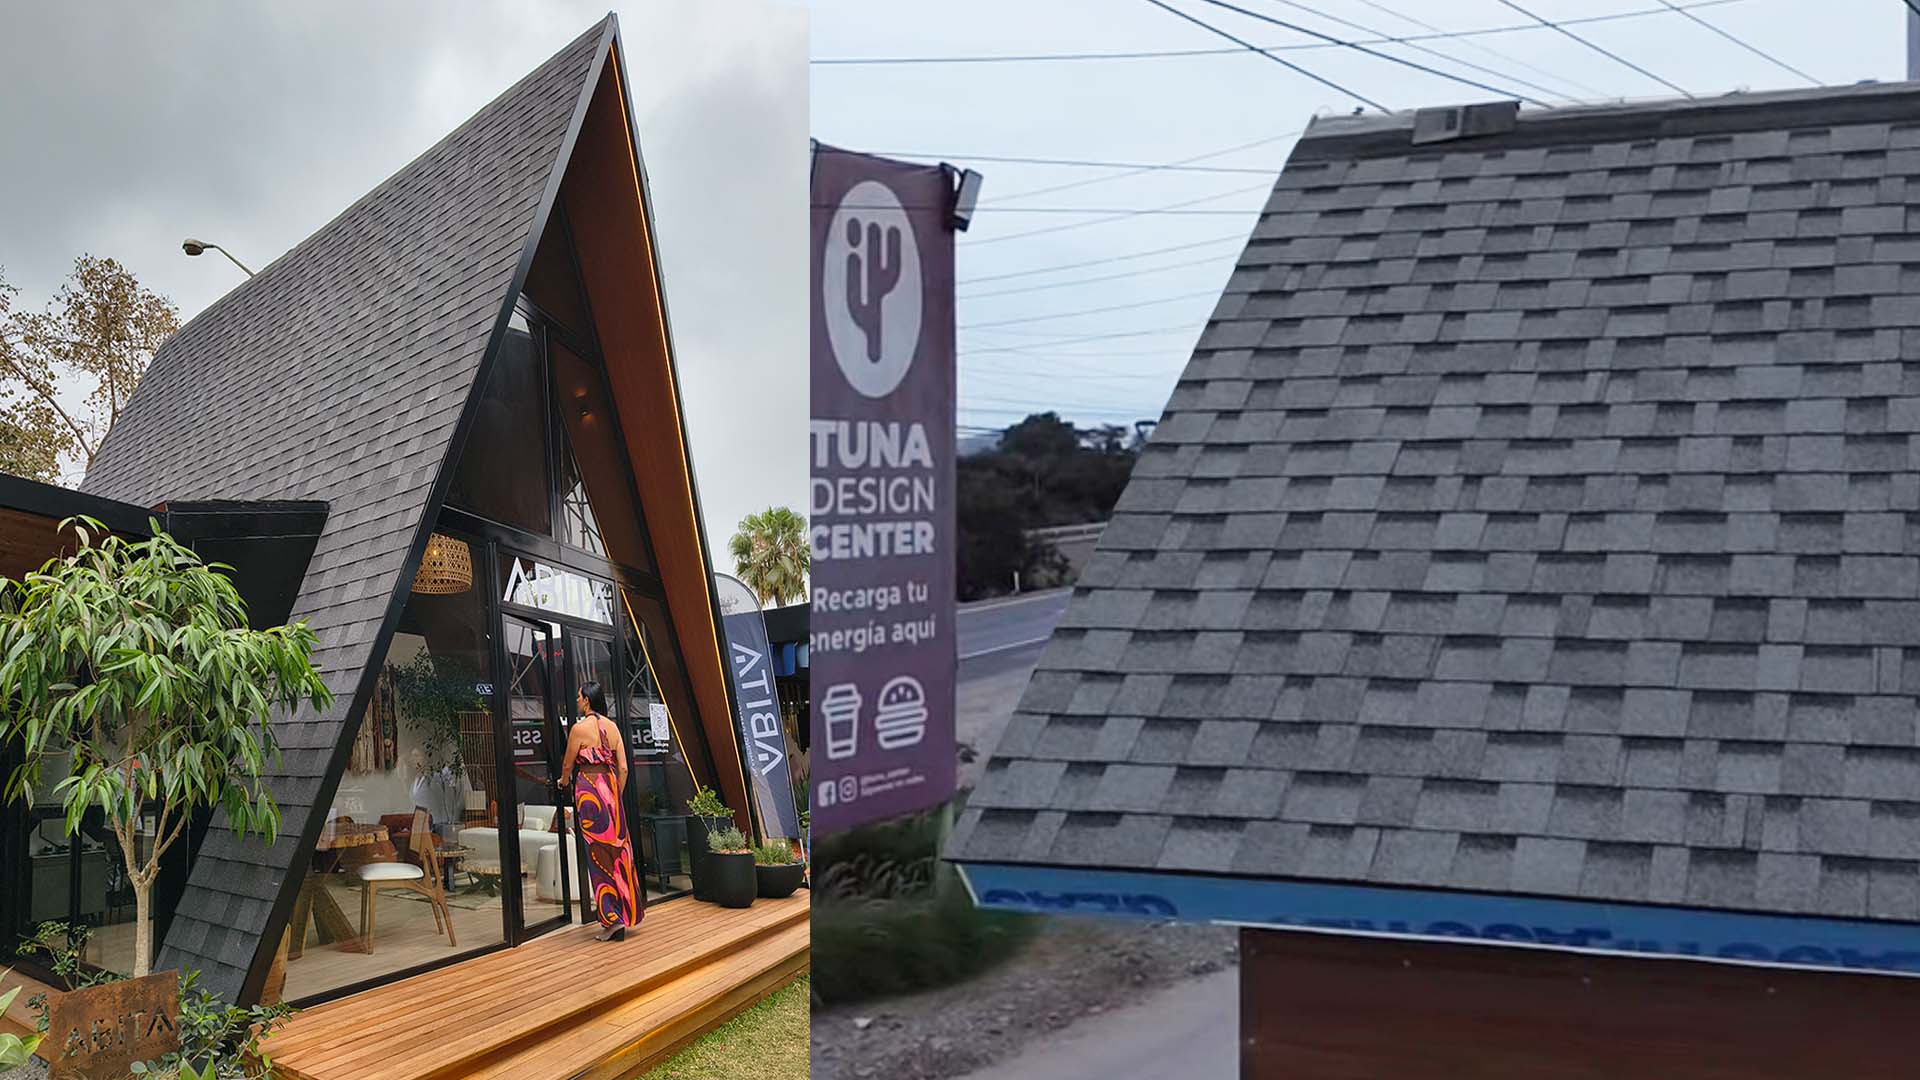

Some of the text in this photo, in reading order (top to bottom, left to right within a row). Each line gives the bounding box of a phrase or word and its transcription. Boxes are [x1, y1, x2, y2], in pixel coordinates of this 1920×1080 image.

[810, 419, 934, 469] TUNA
[810, 476, 935, 516] DESIGN
[810, 520, 935, 561] CENTER
[503, 556, 614, 626] ABITA
[813, 580, 928, 612] Recarga tu
[892, 613, 936, 646] aquí
[731, 641, 784, 777] ABITA
[59, 1007, 174, 1060] ABITA
